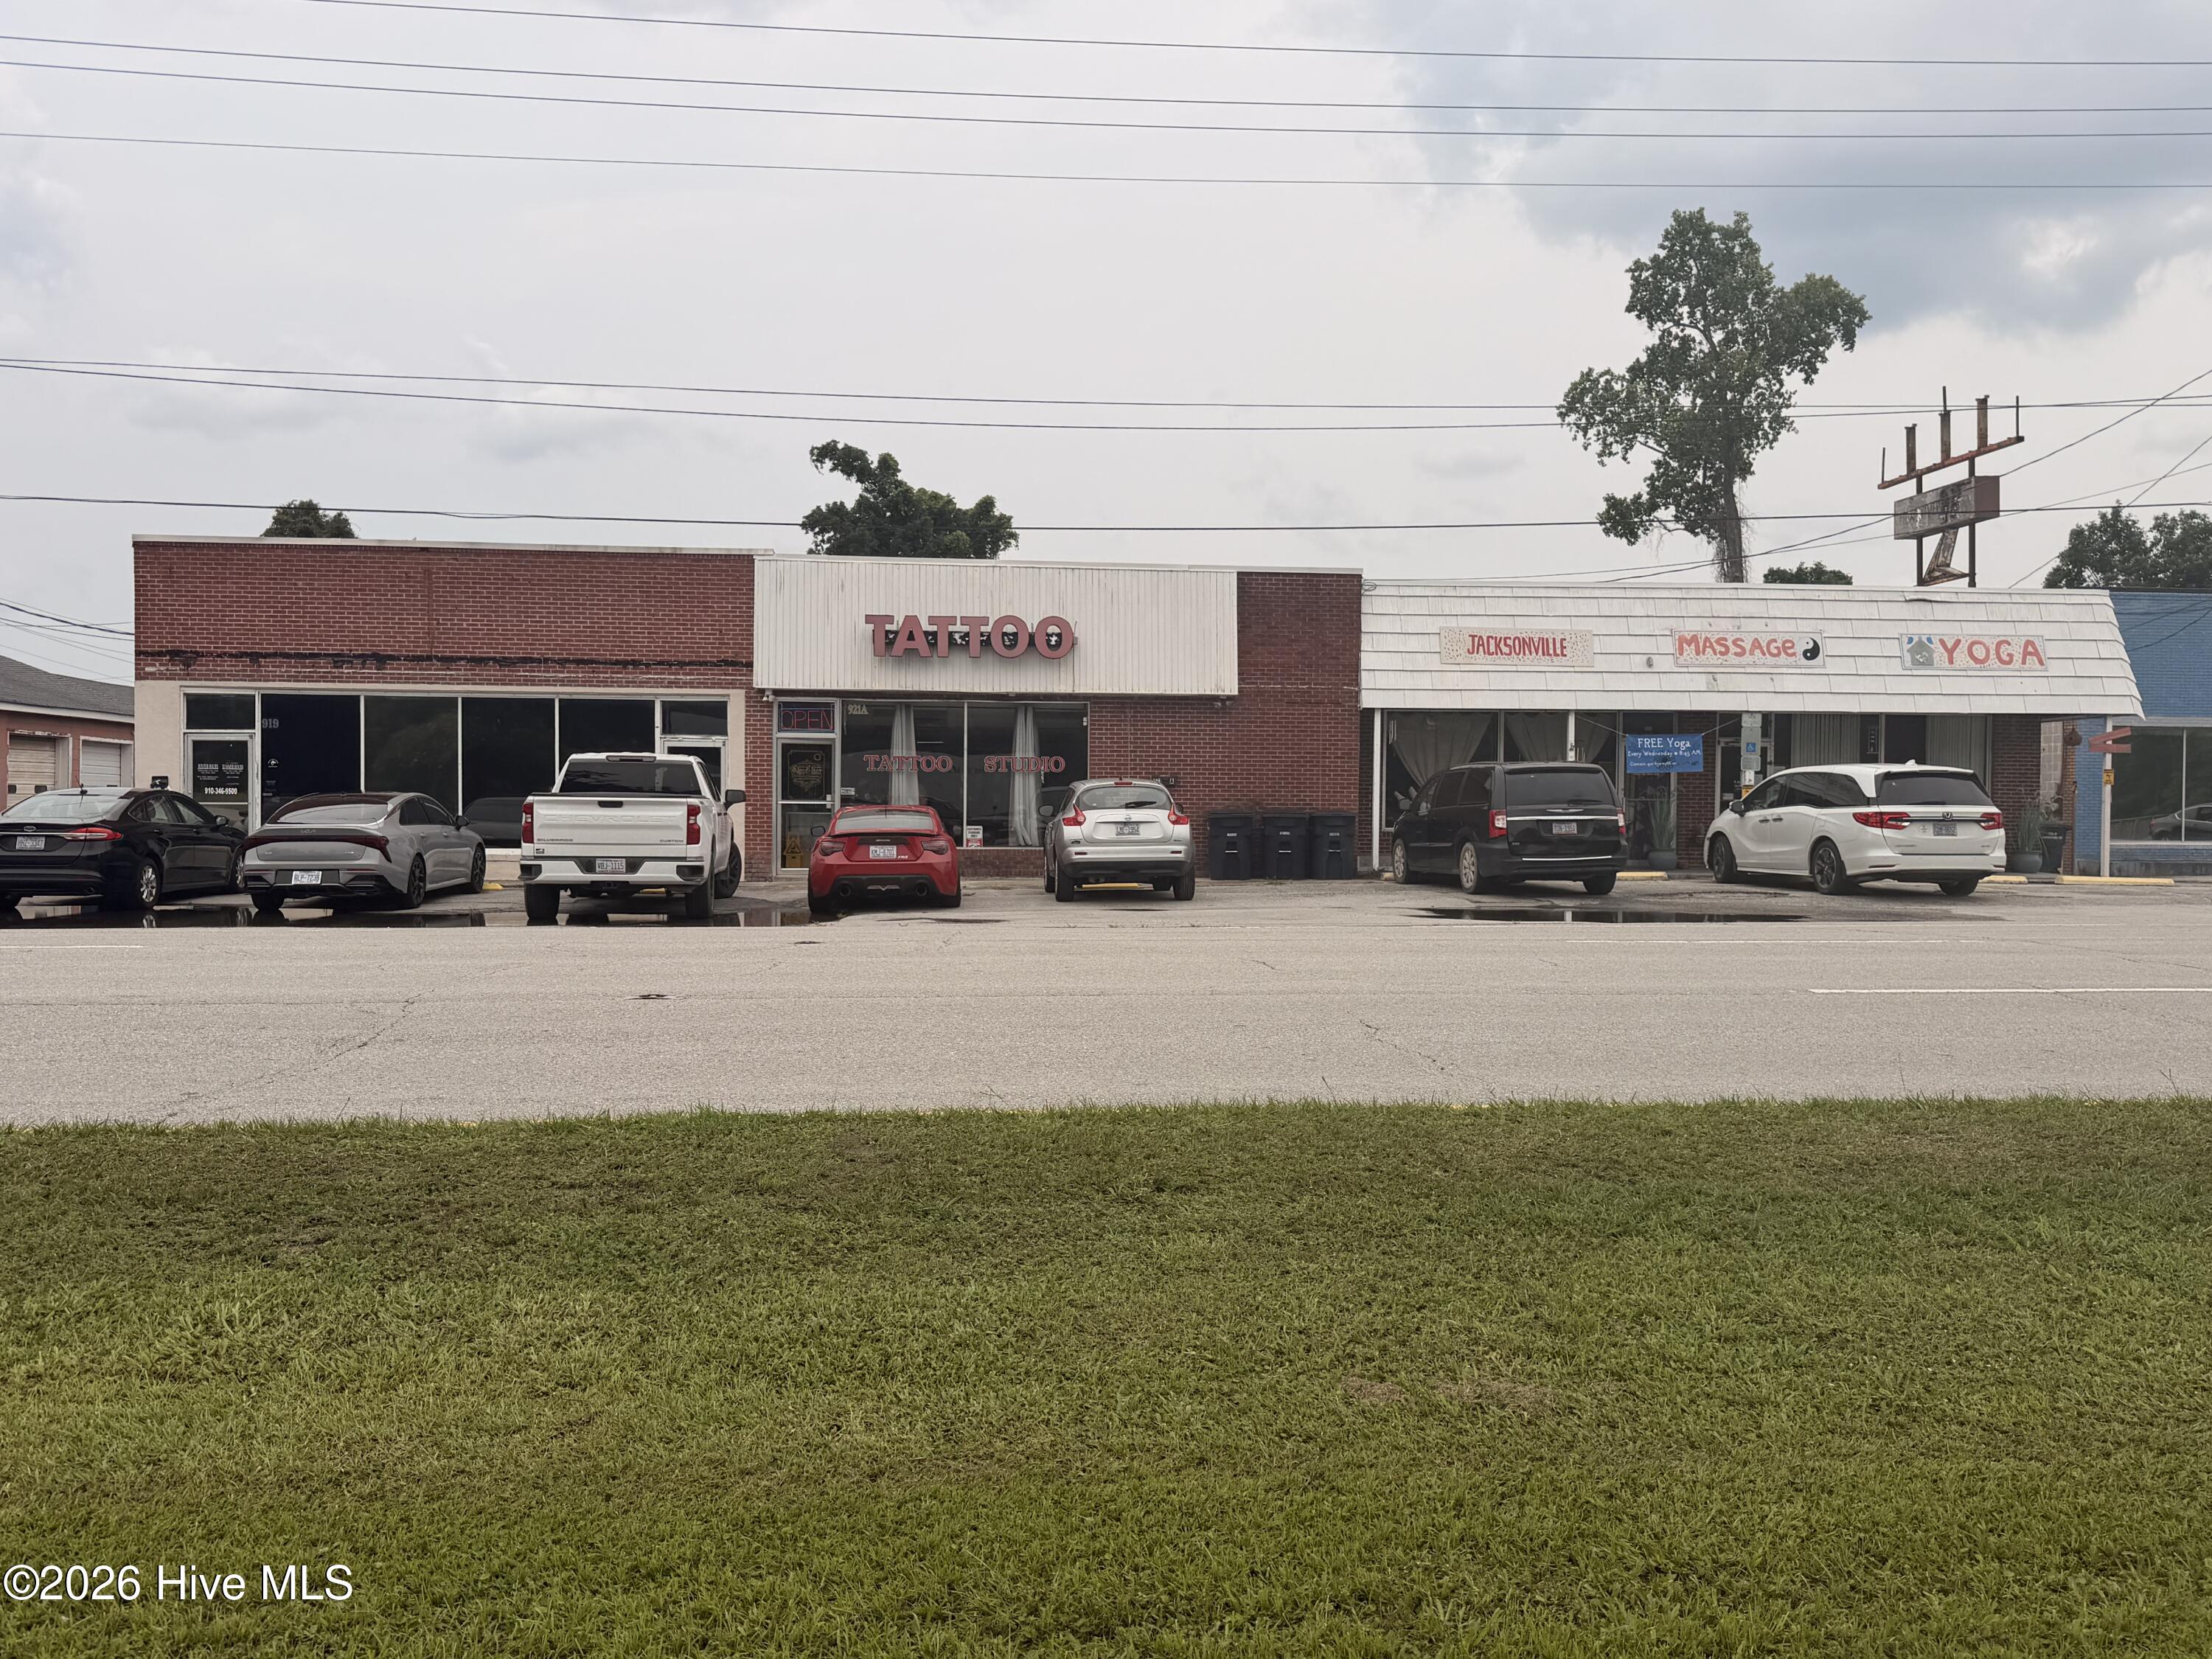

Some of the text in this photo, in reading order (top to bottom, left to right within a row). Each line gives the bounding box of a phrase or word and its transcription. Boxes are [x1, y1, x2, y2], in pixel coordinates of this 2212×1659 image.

[865, 614, 1074, 659] TATTOO
[1467, 633, 1568, 658] JACKSONVILLE
[1938, 638, 2045, 666] YOGA
[848, 704, 869, 714] 921A
[262, 718, 279, 728] 919
[782, 710, 833, 731] OPEN
[1638, 737, 1691, 751] FREE Yoga
[863, 754, 1066, 773] TATTOO STUDIO
[204, 787, 237, 795] 910-346-9500
[543, 814, 677, 824] CHEVROLET
